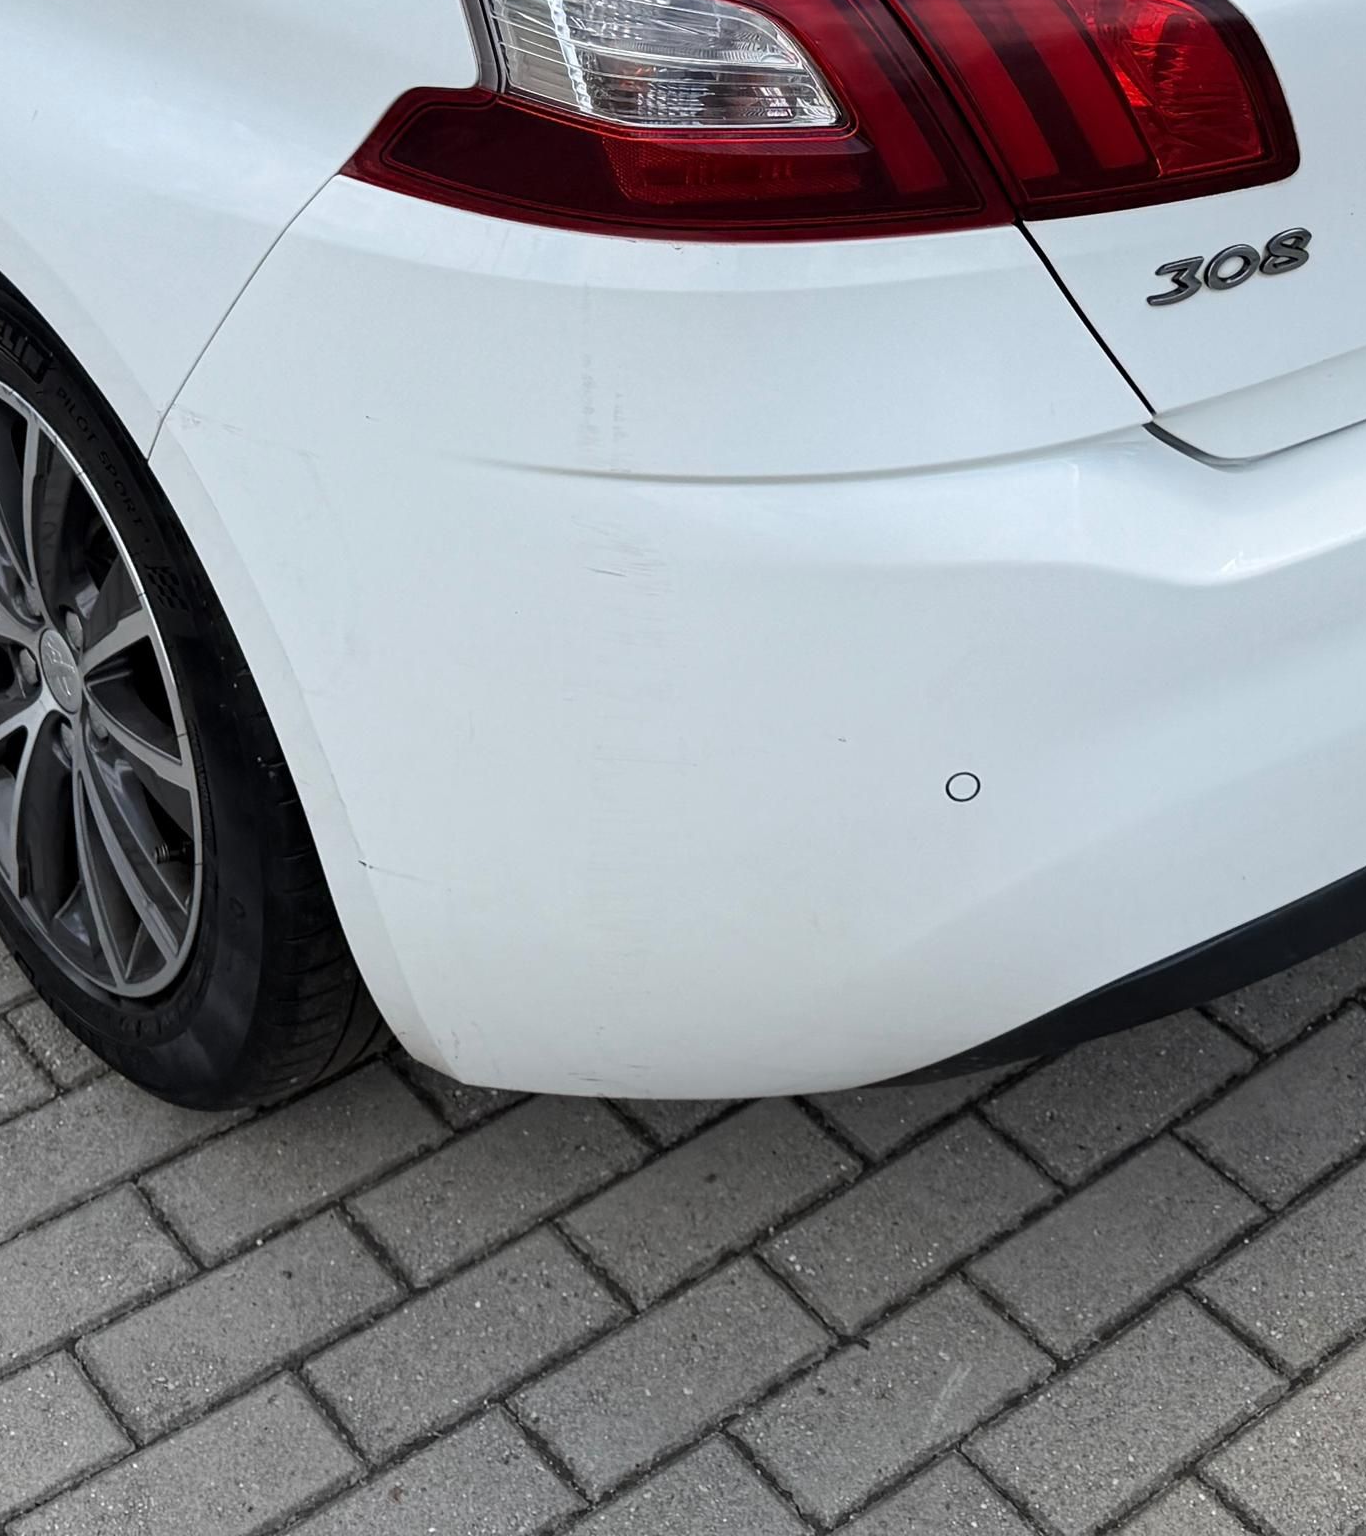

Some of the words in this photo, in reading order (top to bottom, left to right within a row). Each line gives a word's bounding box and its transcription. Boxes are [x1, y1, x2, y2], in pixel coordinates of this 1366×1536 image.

[1147, 227, 1312, 306] 308
[57, 387, 97, 442] PILOT
[98, 450, 143, 525] SPORT
